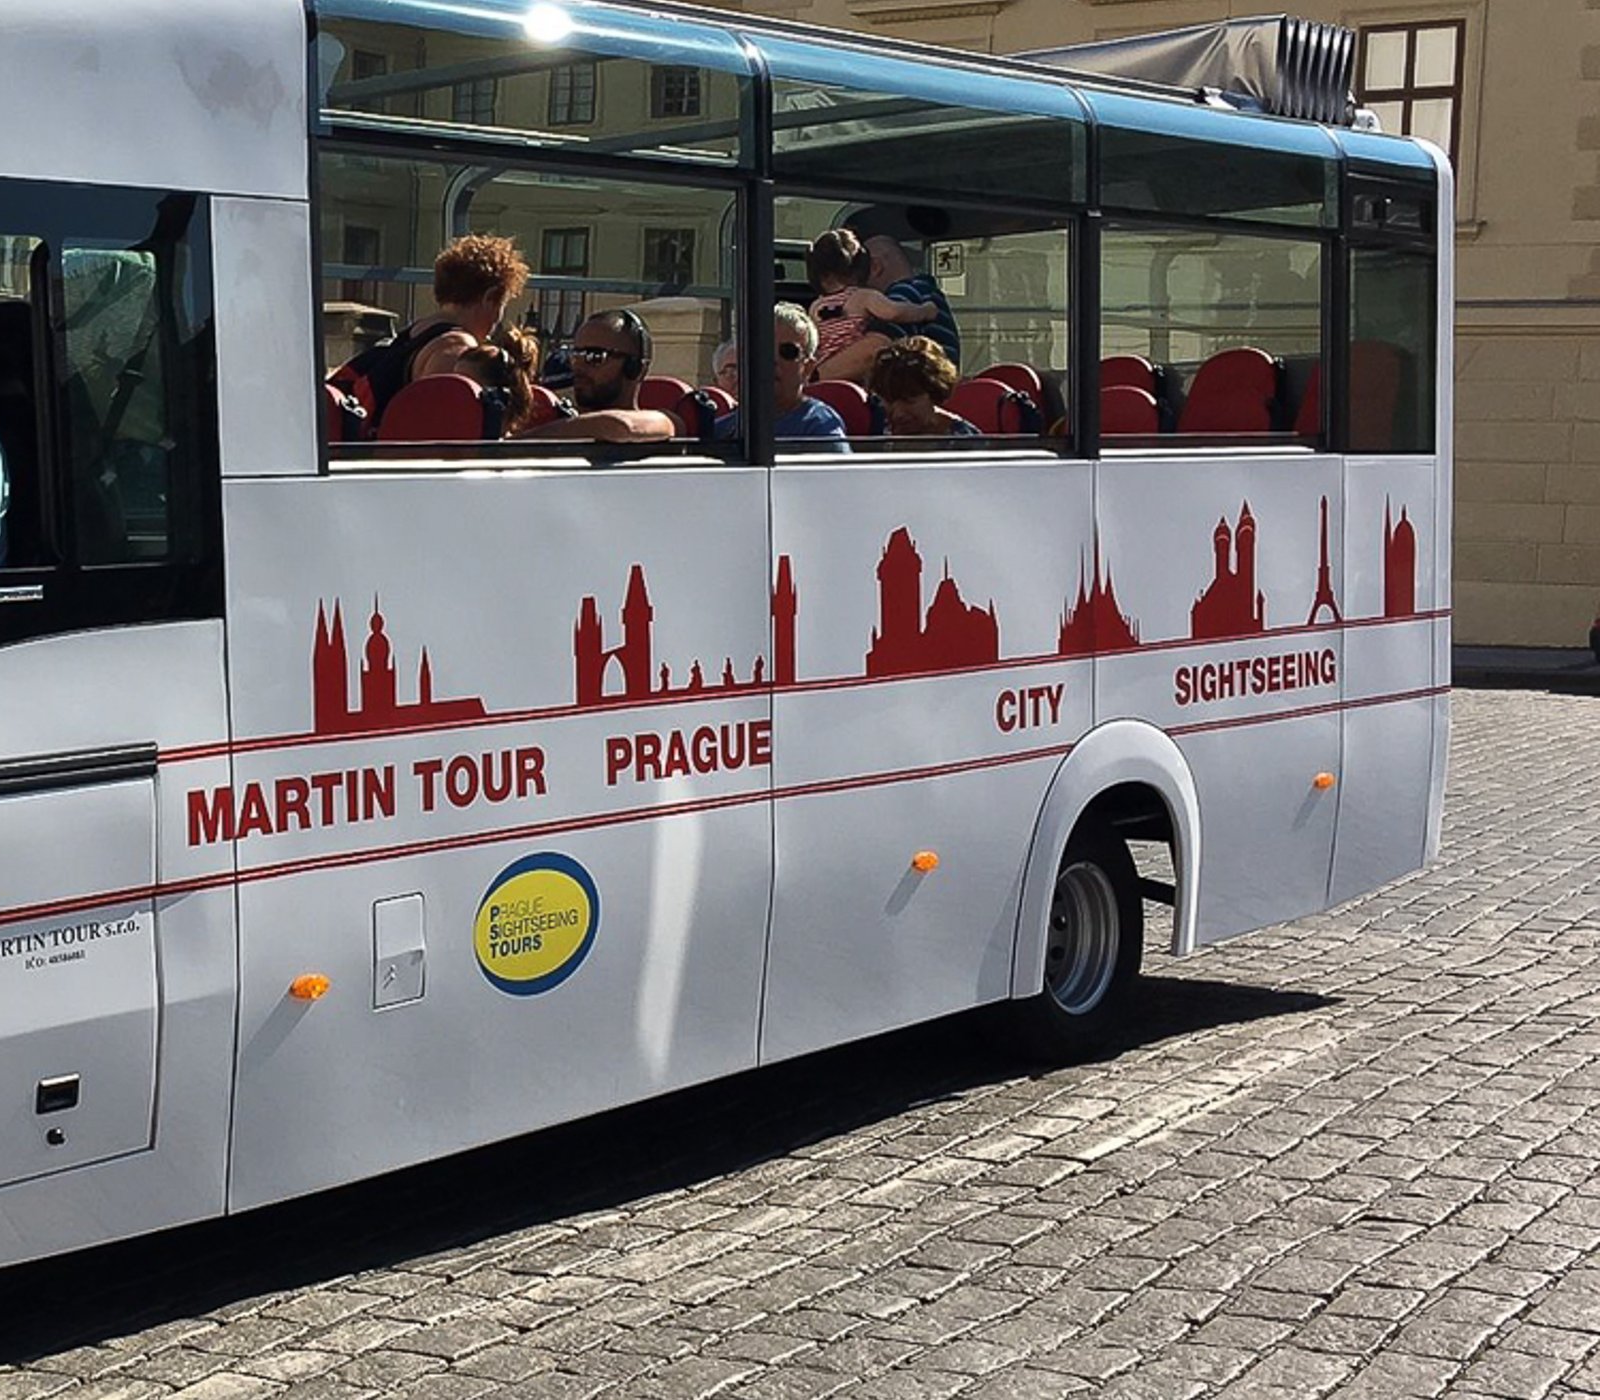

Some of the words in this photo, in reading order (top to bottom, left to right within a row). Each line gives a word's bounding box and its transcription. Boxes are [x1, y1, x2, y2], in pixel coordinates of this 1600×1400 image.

[187, 765, 395, 846] MARTIN
[413, 746, 547, 812] TOUR
[606, 720, 772, 786] PRAGUE
[996, 683, 1064, 732] CITY
[1175, 649, 1336, 705] SIGHTSEEING
[490, 896, 544, 922] PRAGUE
[50, 923, 101, 946] TOUR
[105, 919, 140, 937] s.r.o.
[489, 909, 578, 940] SIGHTSEEING
[489, 934, 542, 958] TOURS
